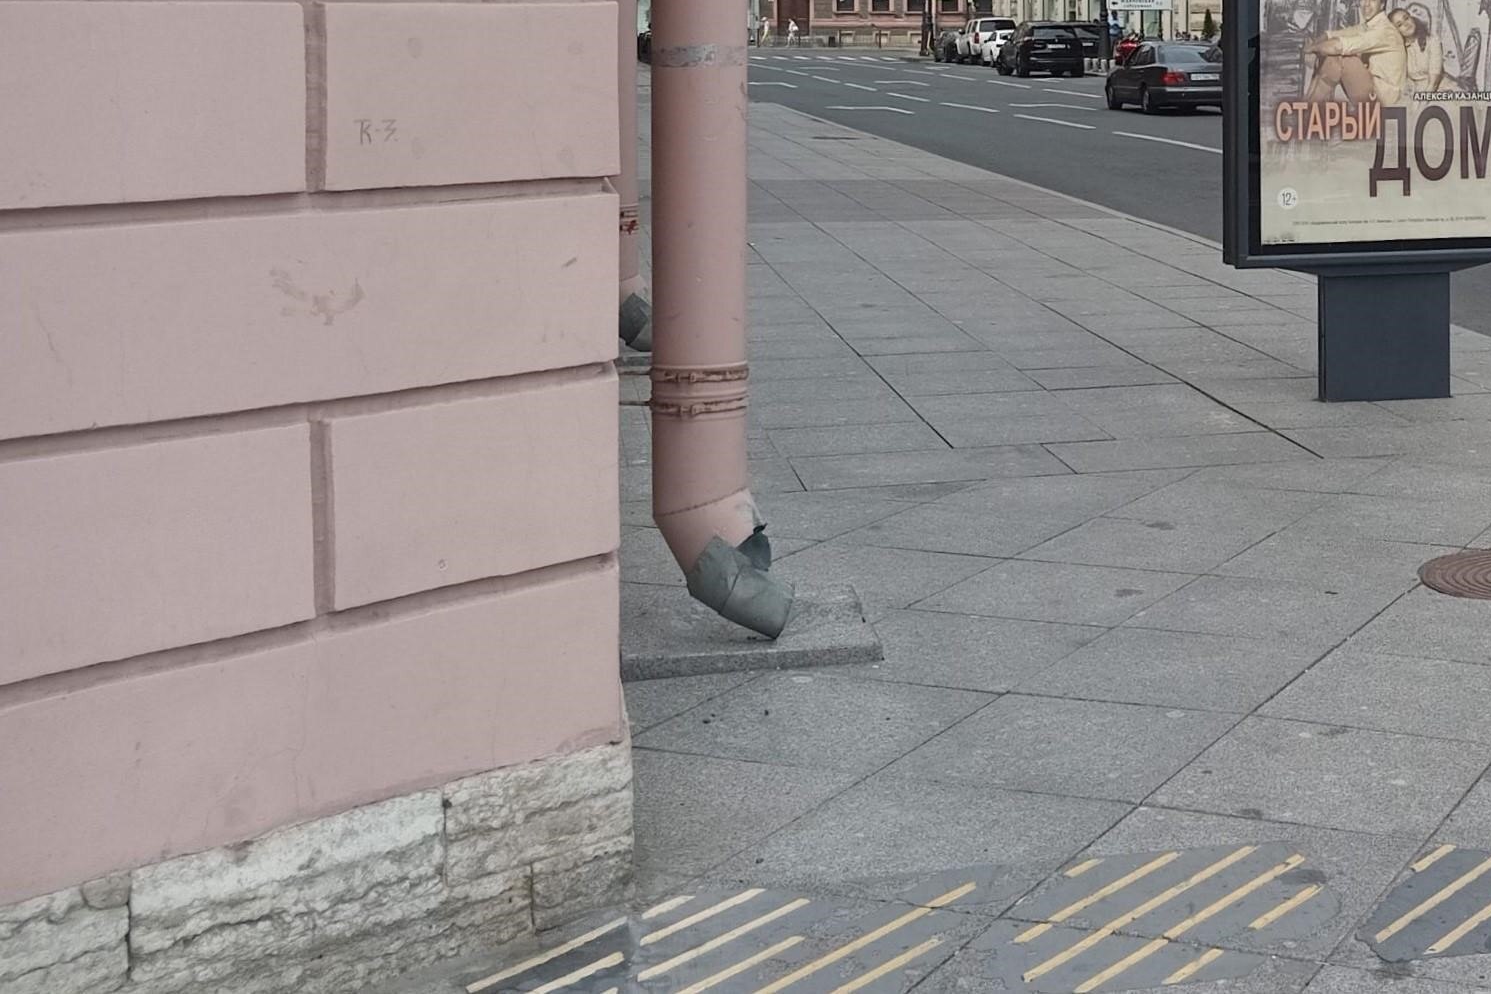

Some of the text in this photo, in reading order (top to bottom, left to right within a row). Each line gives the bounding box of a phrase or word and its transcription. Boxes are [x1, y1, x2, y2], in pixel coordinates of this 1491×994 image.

[1413, 90, 1453, 101] АЛЕКСЕЙ
[1276, 93, 1382, 142] СТАРЫЙ
[1281, 192, 1297, 206] 12+
